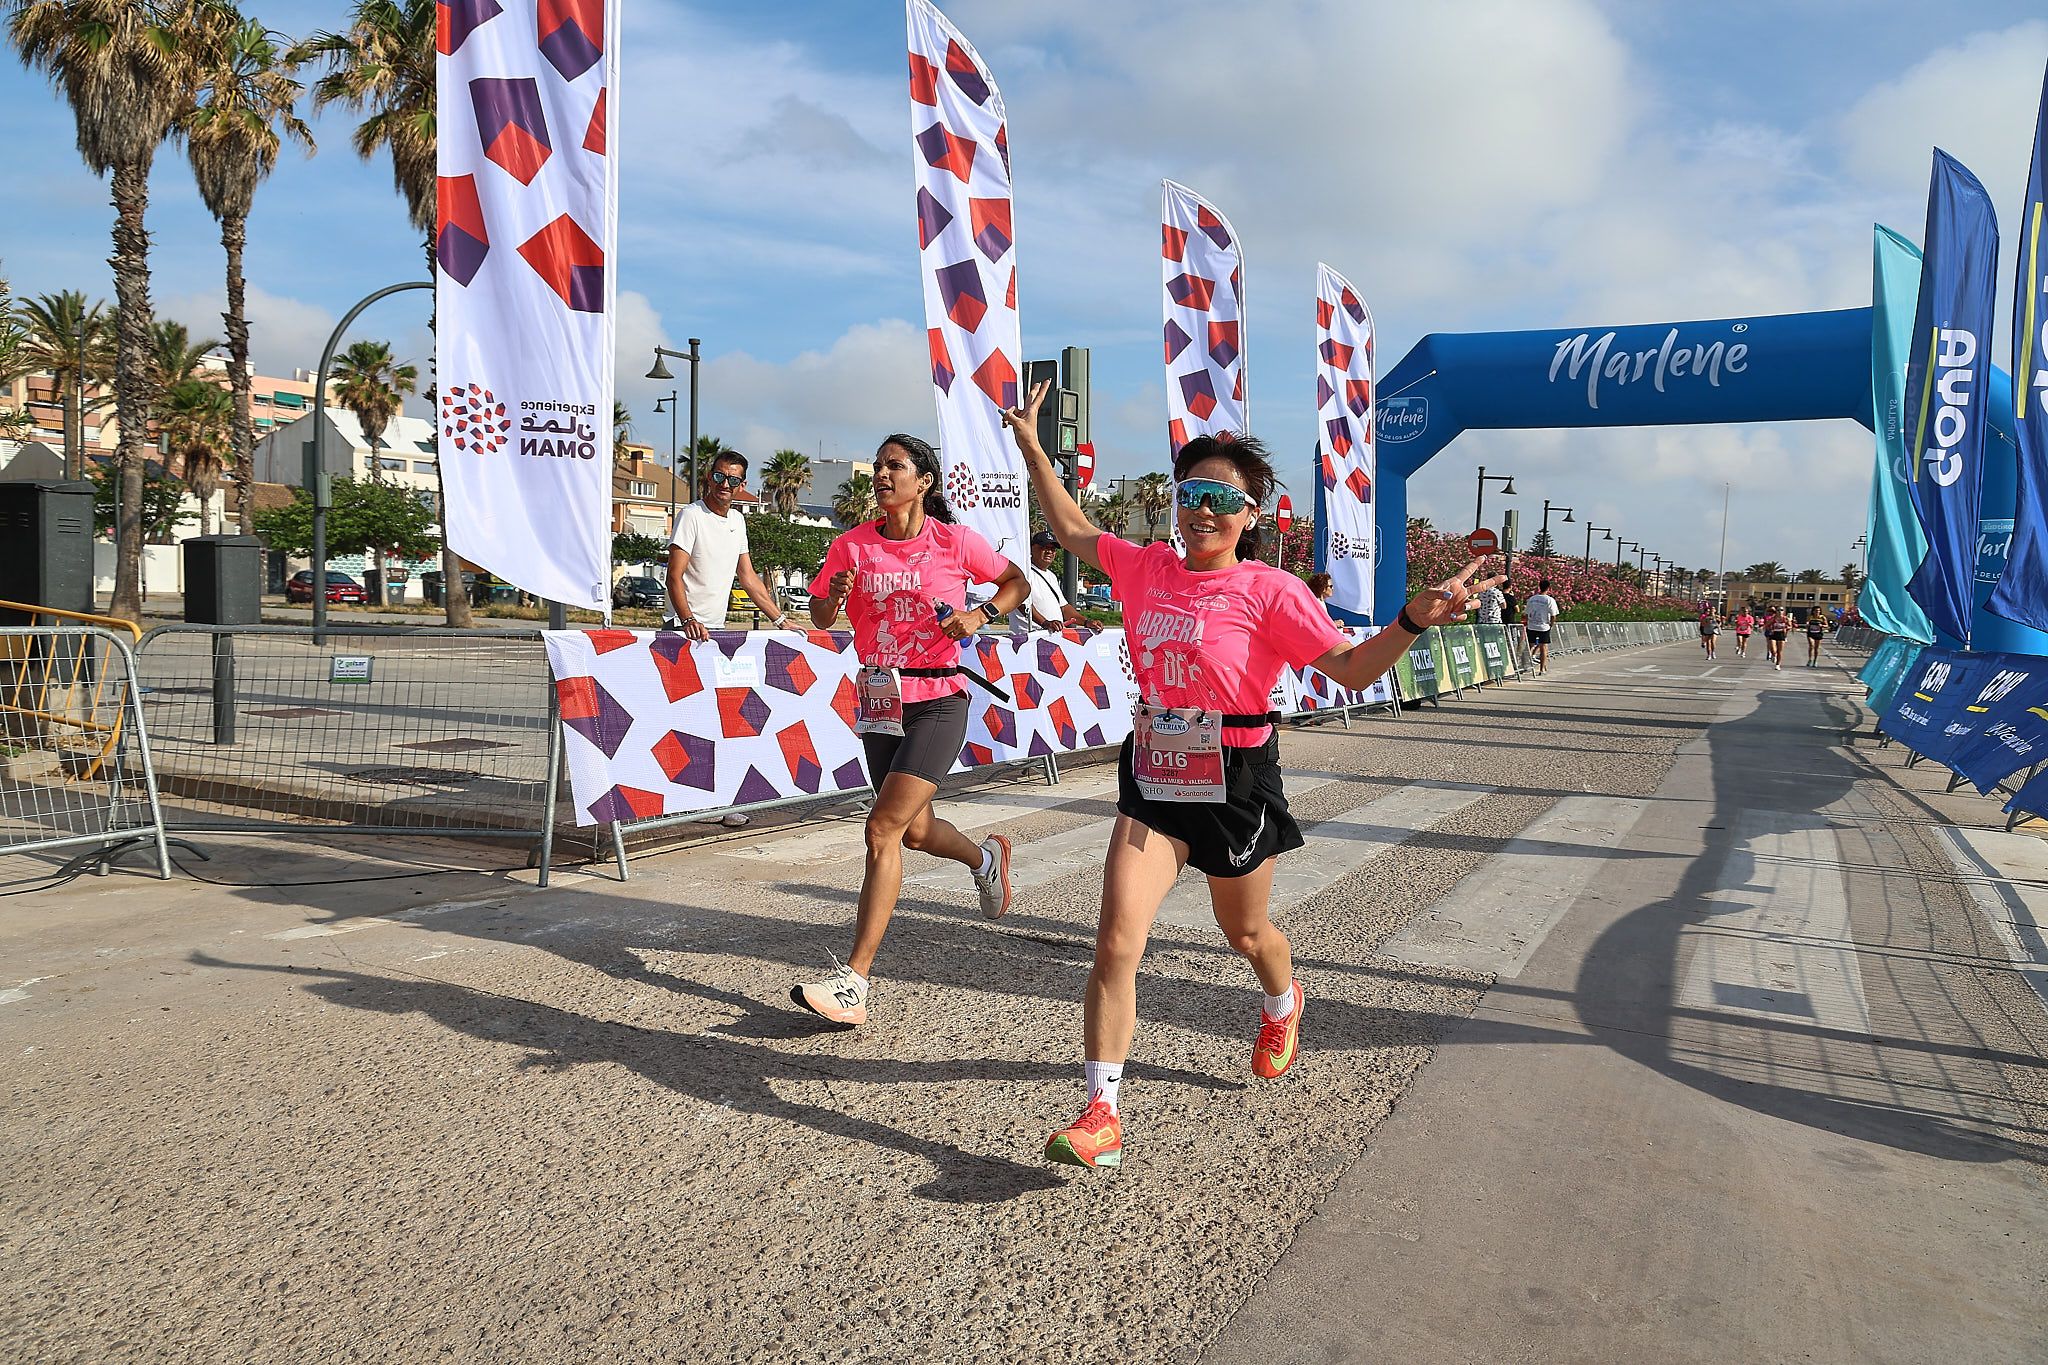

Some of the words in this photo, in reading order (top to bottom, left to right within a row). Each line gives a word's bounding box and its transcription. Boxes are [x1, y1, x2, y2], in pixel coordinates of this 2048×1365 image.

[894, 597, 915, 622] DE
[1164, 650, 1187, 689] DE
[1272, 696, 1286, 706] MAN
[1151, 750, 1188, 768] 016
[1162, 769, 1179, 777] 3287
